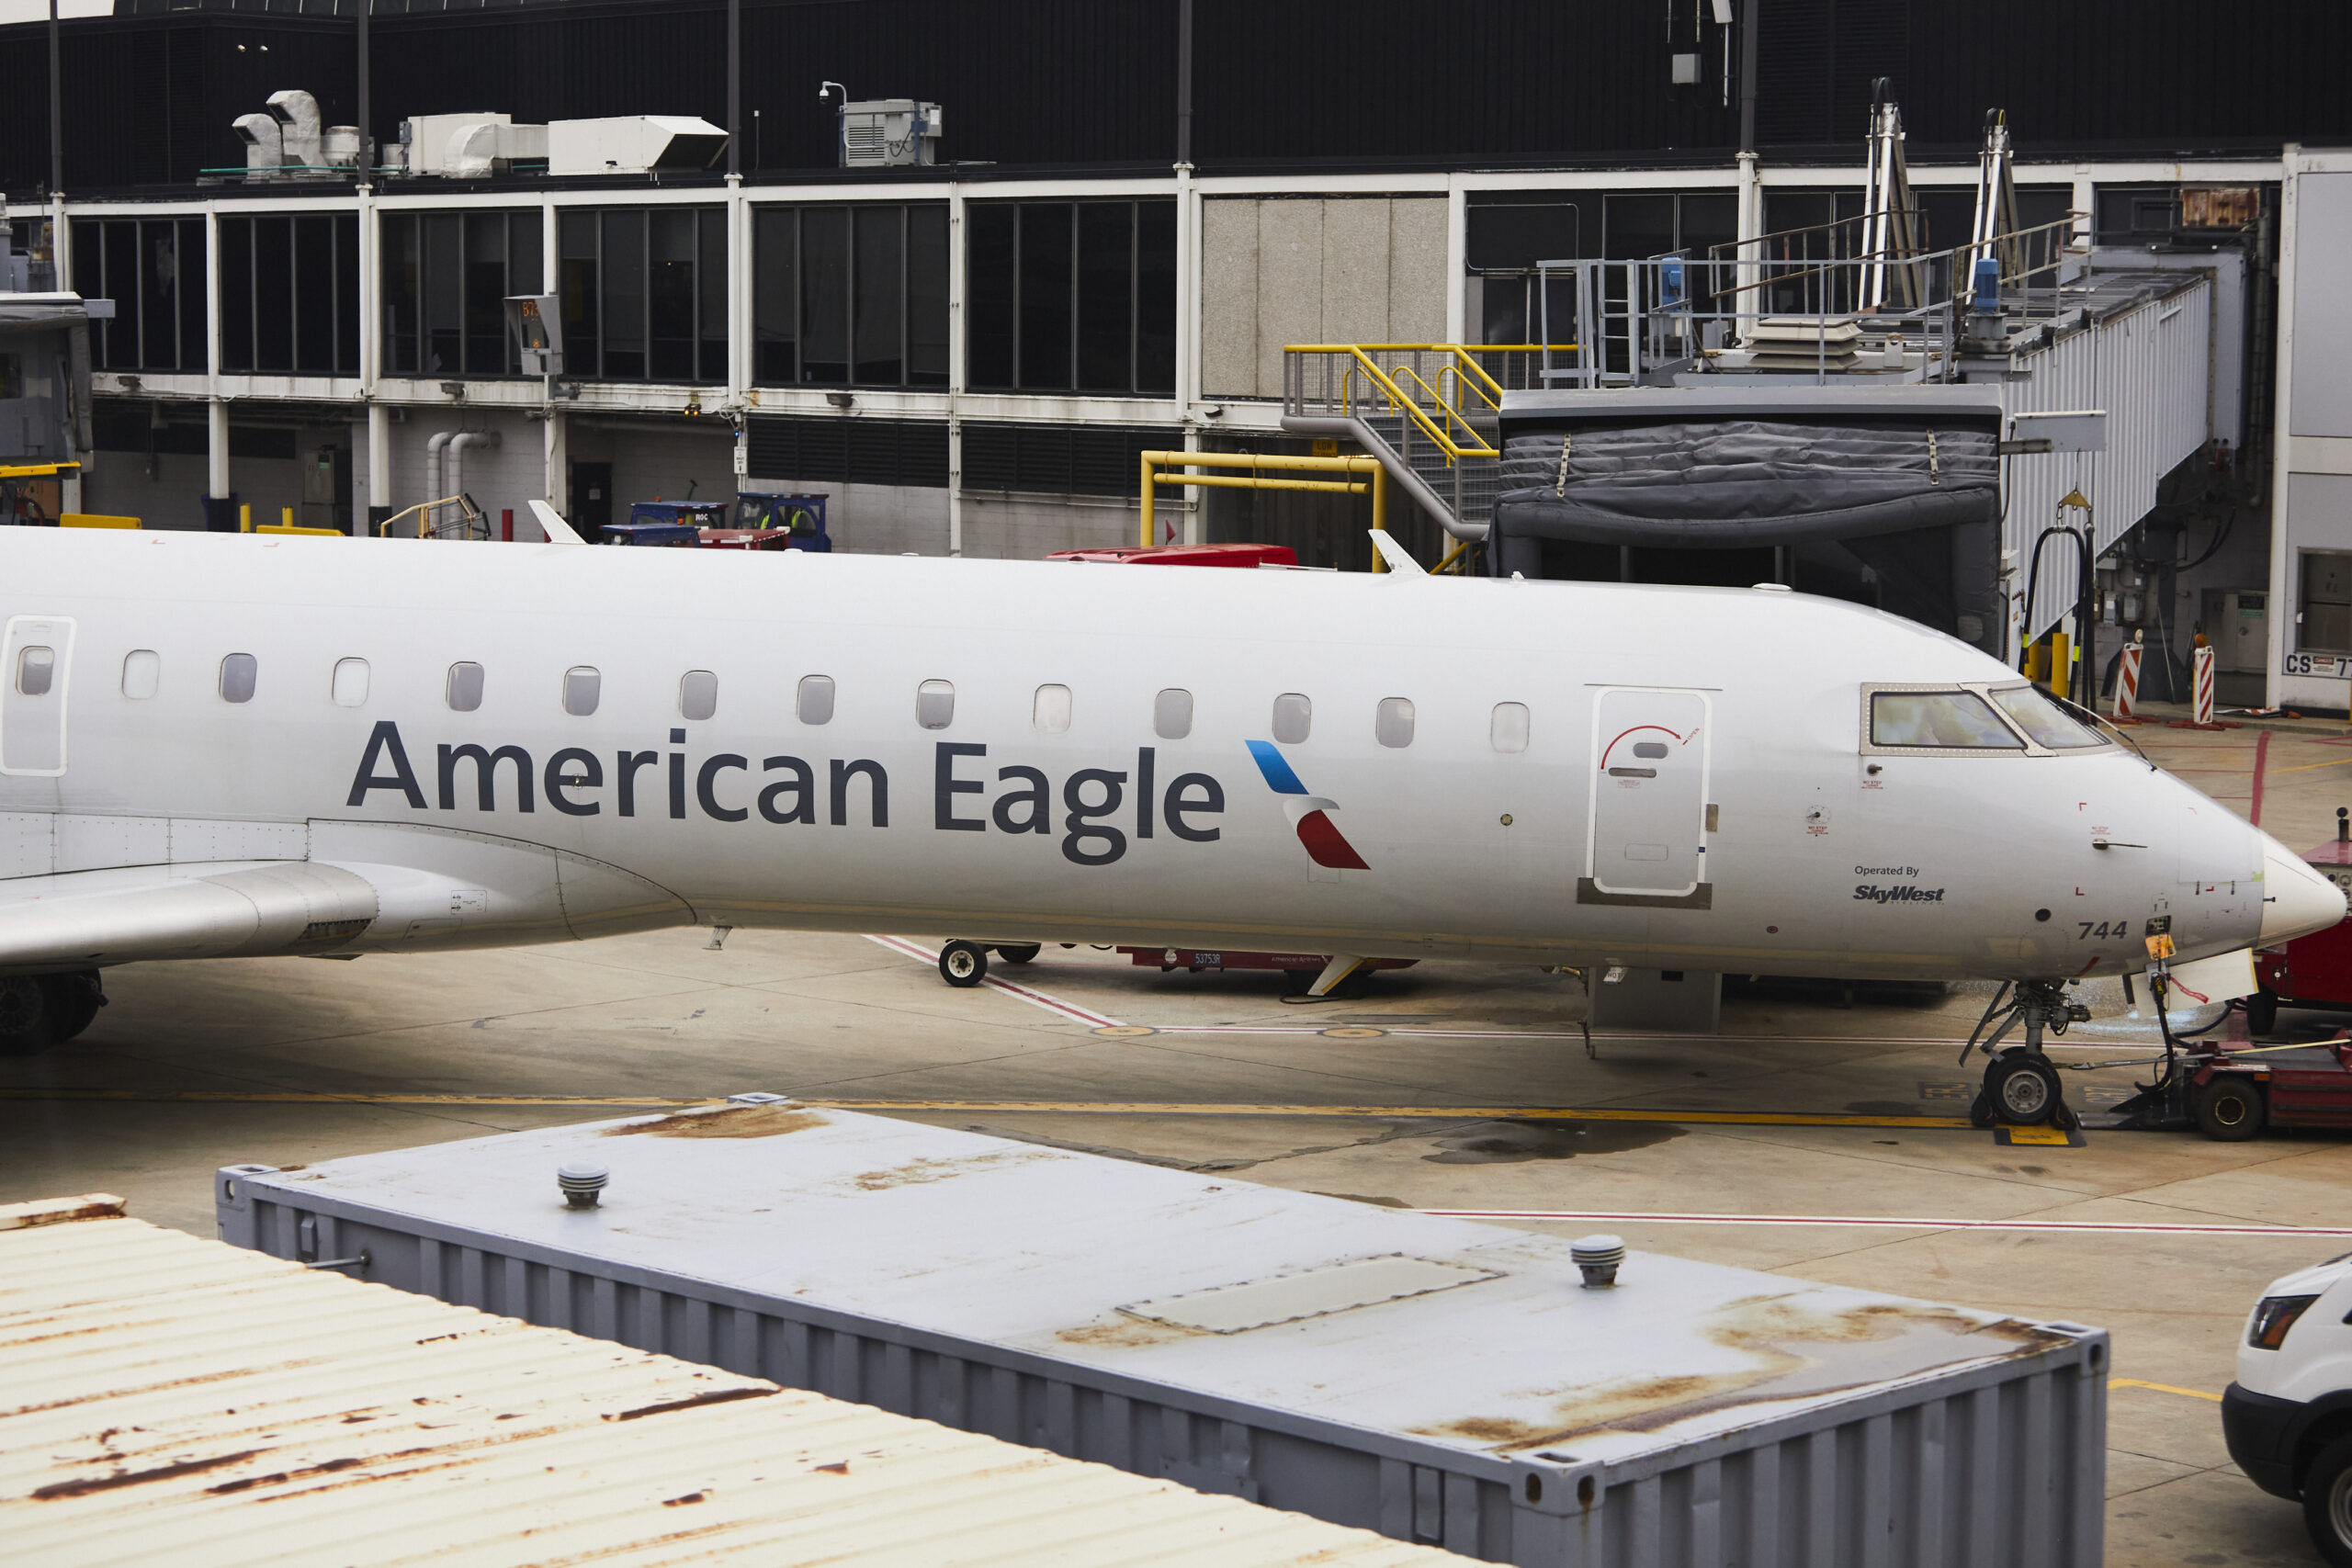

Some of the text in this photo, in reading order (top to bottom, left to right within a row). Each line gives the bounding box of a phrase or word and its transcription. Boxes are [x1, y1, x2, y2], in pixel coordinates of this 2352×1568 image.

[2286, 654, 2311, 673] CS
[345, 720, 1226, 866] American Eagle
[1855, 866, 1919, 877] Operated By
[1853, 885, 1945, 904] SkyWest
[2077, 920, 2128, 940] 744
